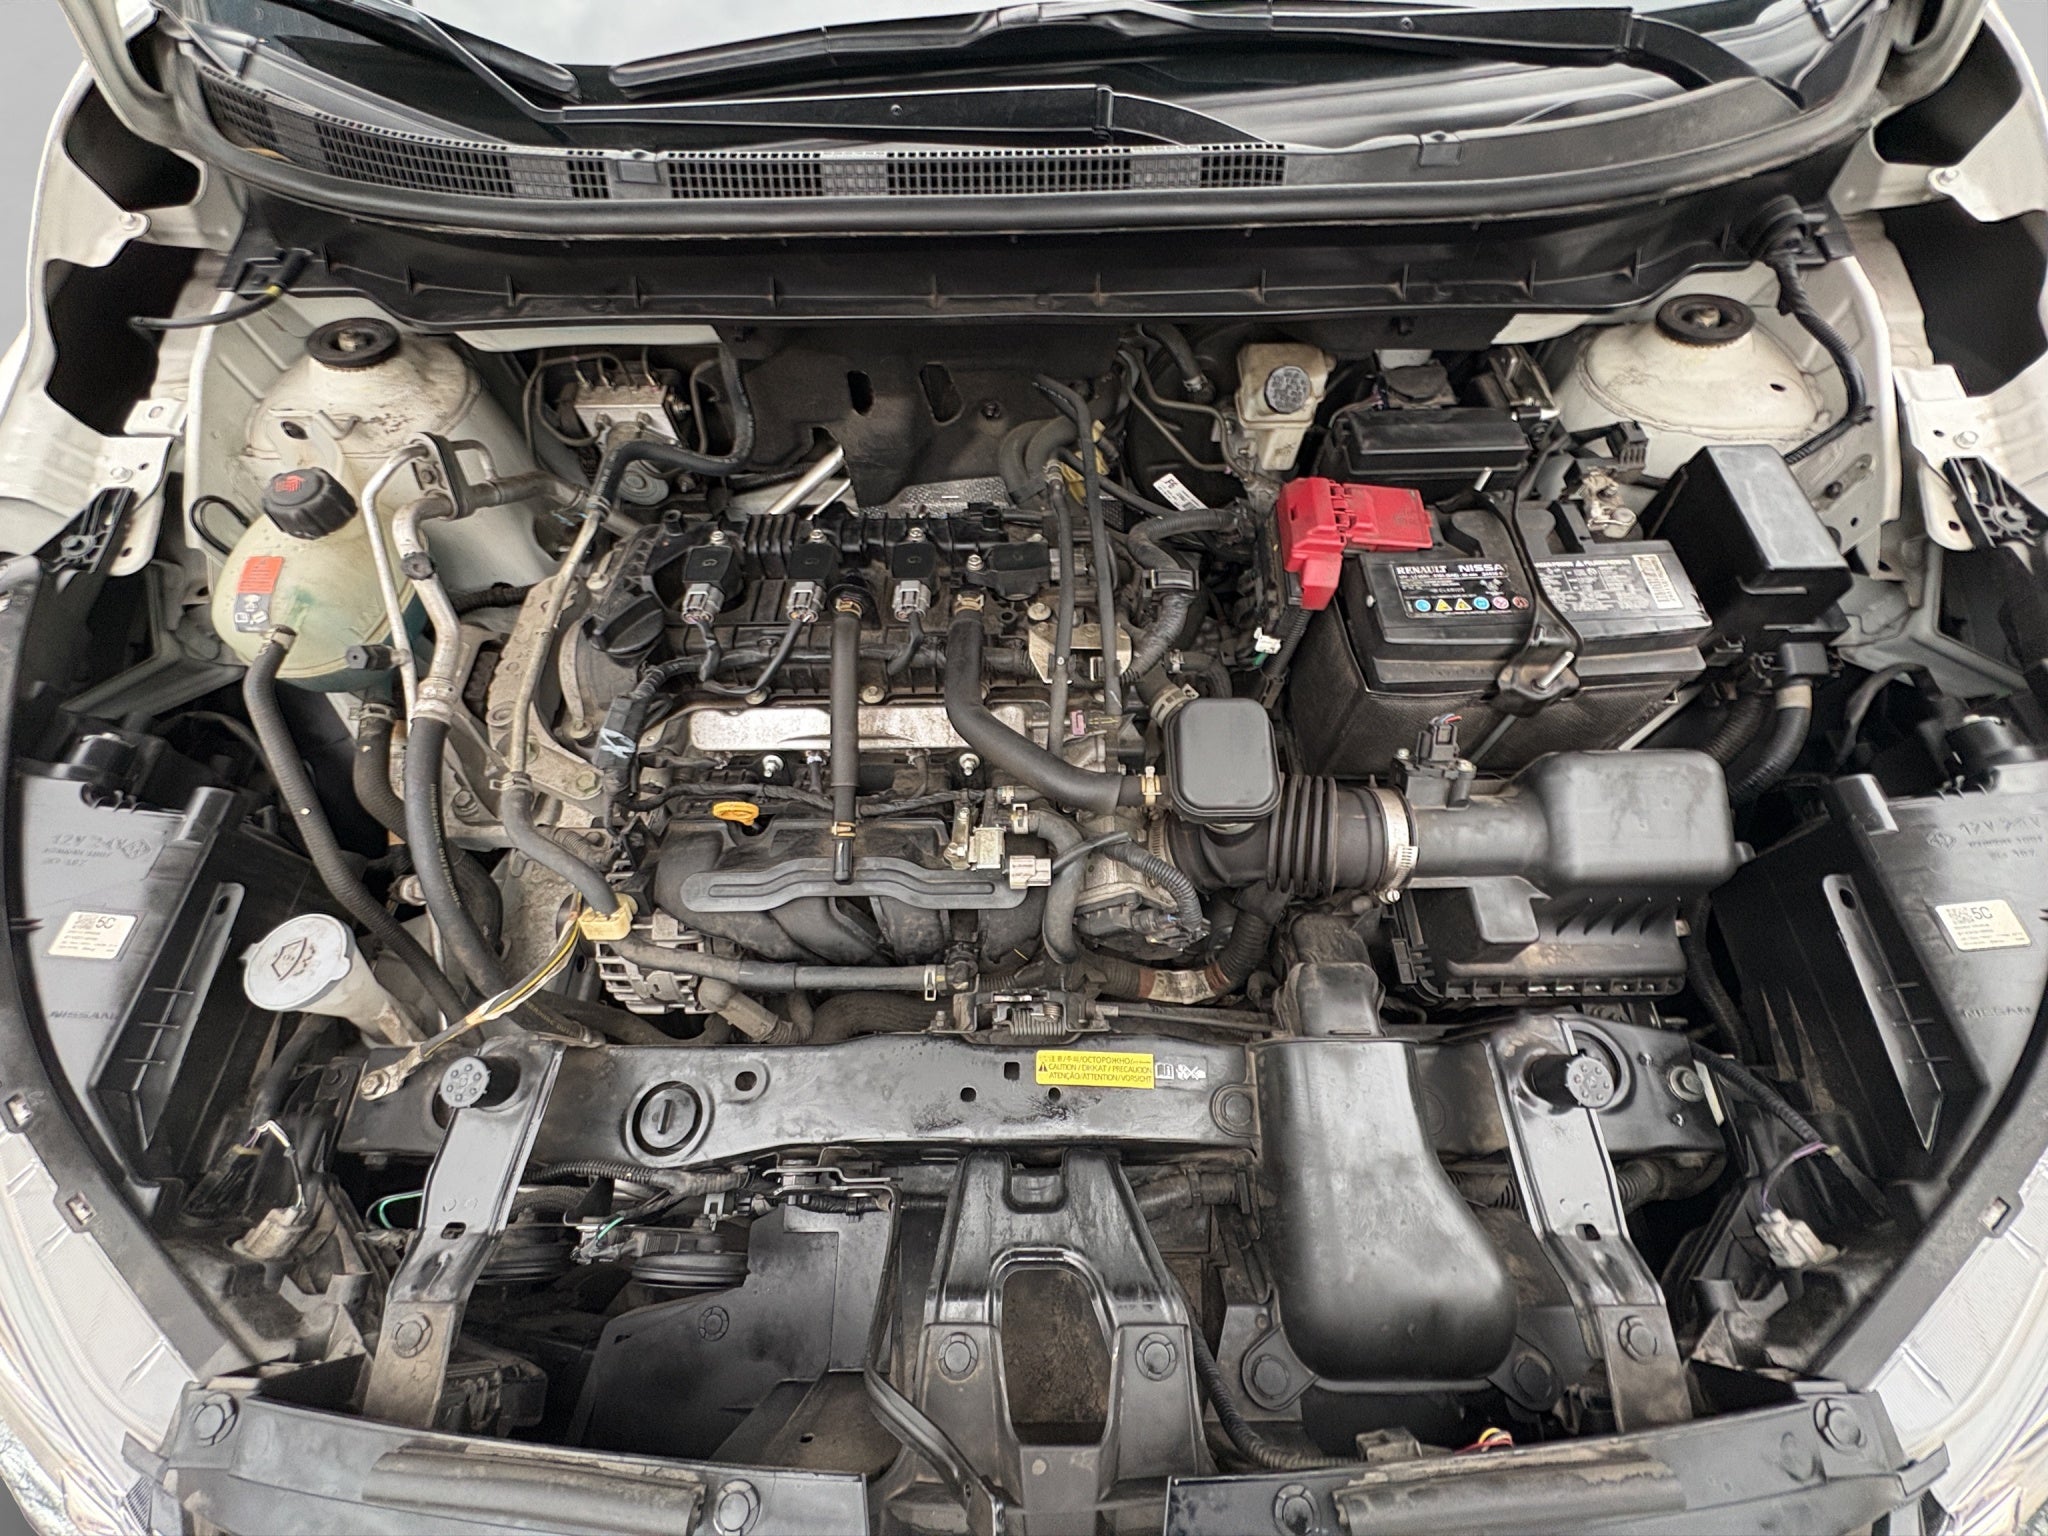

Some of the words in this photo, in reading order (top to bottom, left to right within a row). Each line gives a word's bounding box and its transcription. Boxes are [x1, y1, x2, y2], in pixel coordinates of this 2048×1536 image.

[1396, 565, 1448, 575] RENAULT
[1457, 563, 1506, 573] NISSA
[1970, 906, 1993, 920] 5C
[95, 916, 117, 930] 5C
[50, 1010, 116, 1020] NISSAN
[1048, 1063, 1077, 1071] CAUTION
